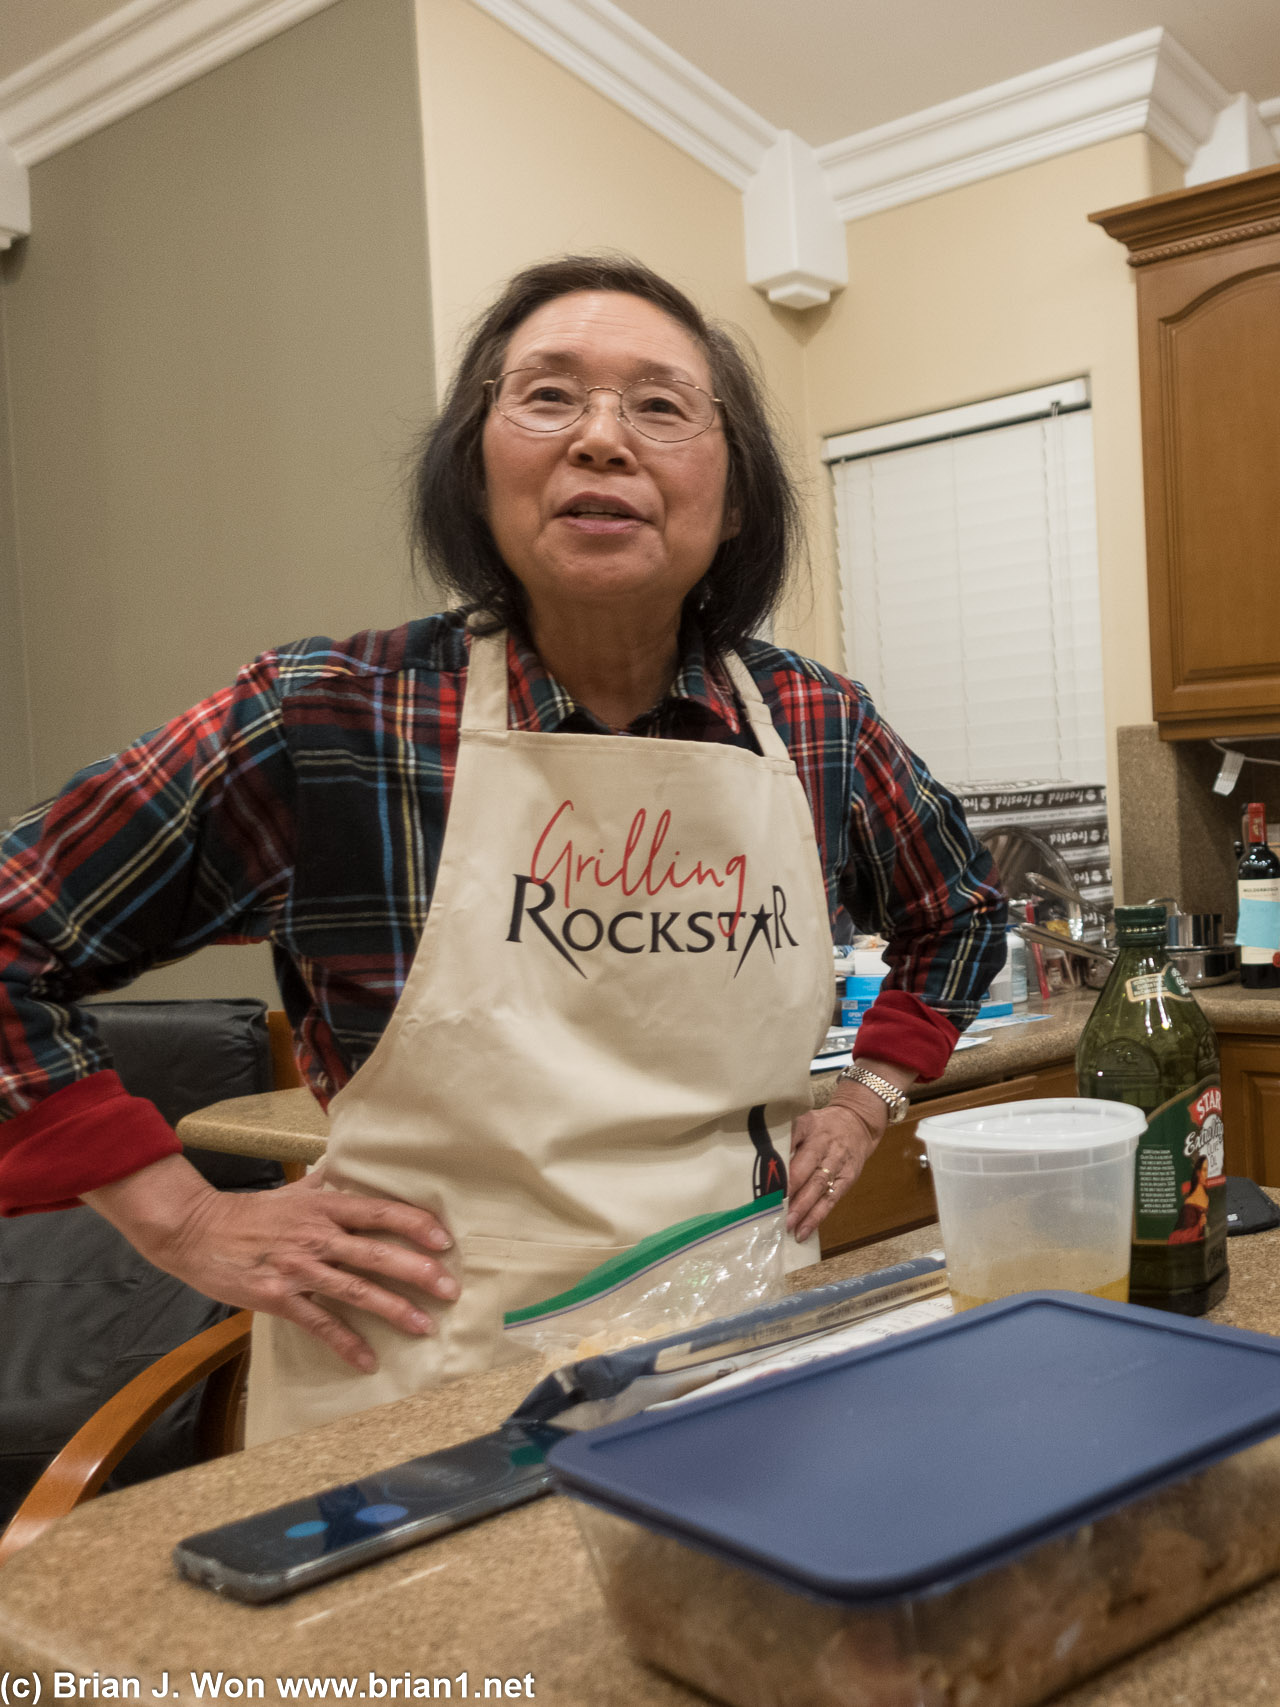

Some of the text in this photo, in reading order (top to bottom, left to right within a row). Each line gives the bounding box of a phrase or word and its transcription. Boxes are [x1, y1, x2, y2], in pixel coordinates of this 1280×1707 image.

[530, 799, 747, 938] Grilling
[505, 873, 799, 980] ROCKSTAR
[1196, 1089, 1222, 1120] STAR
